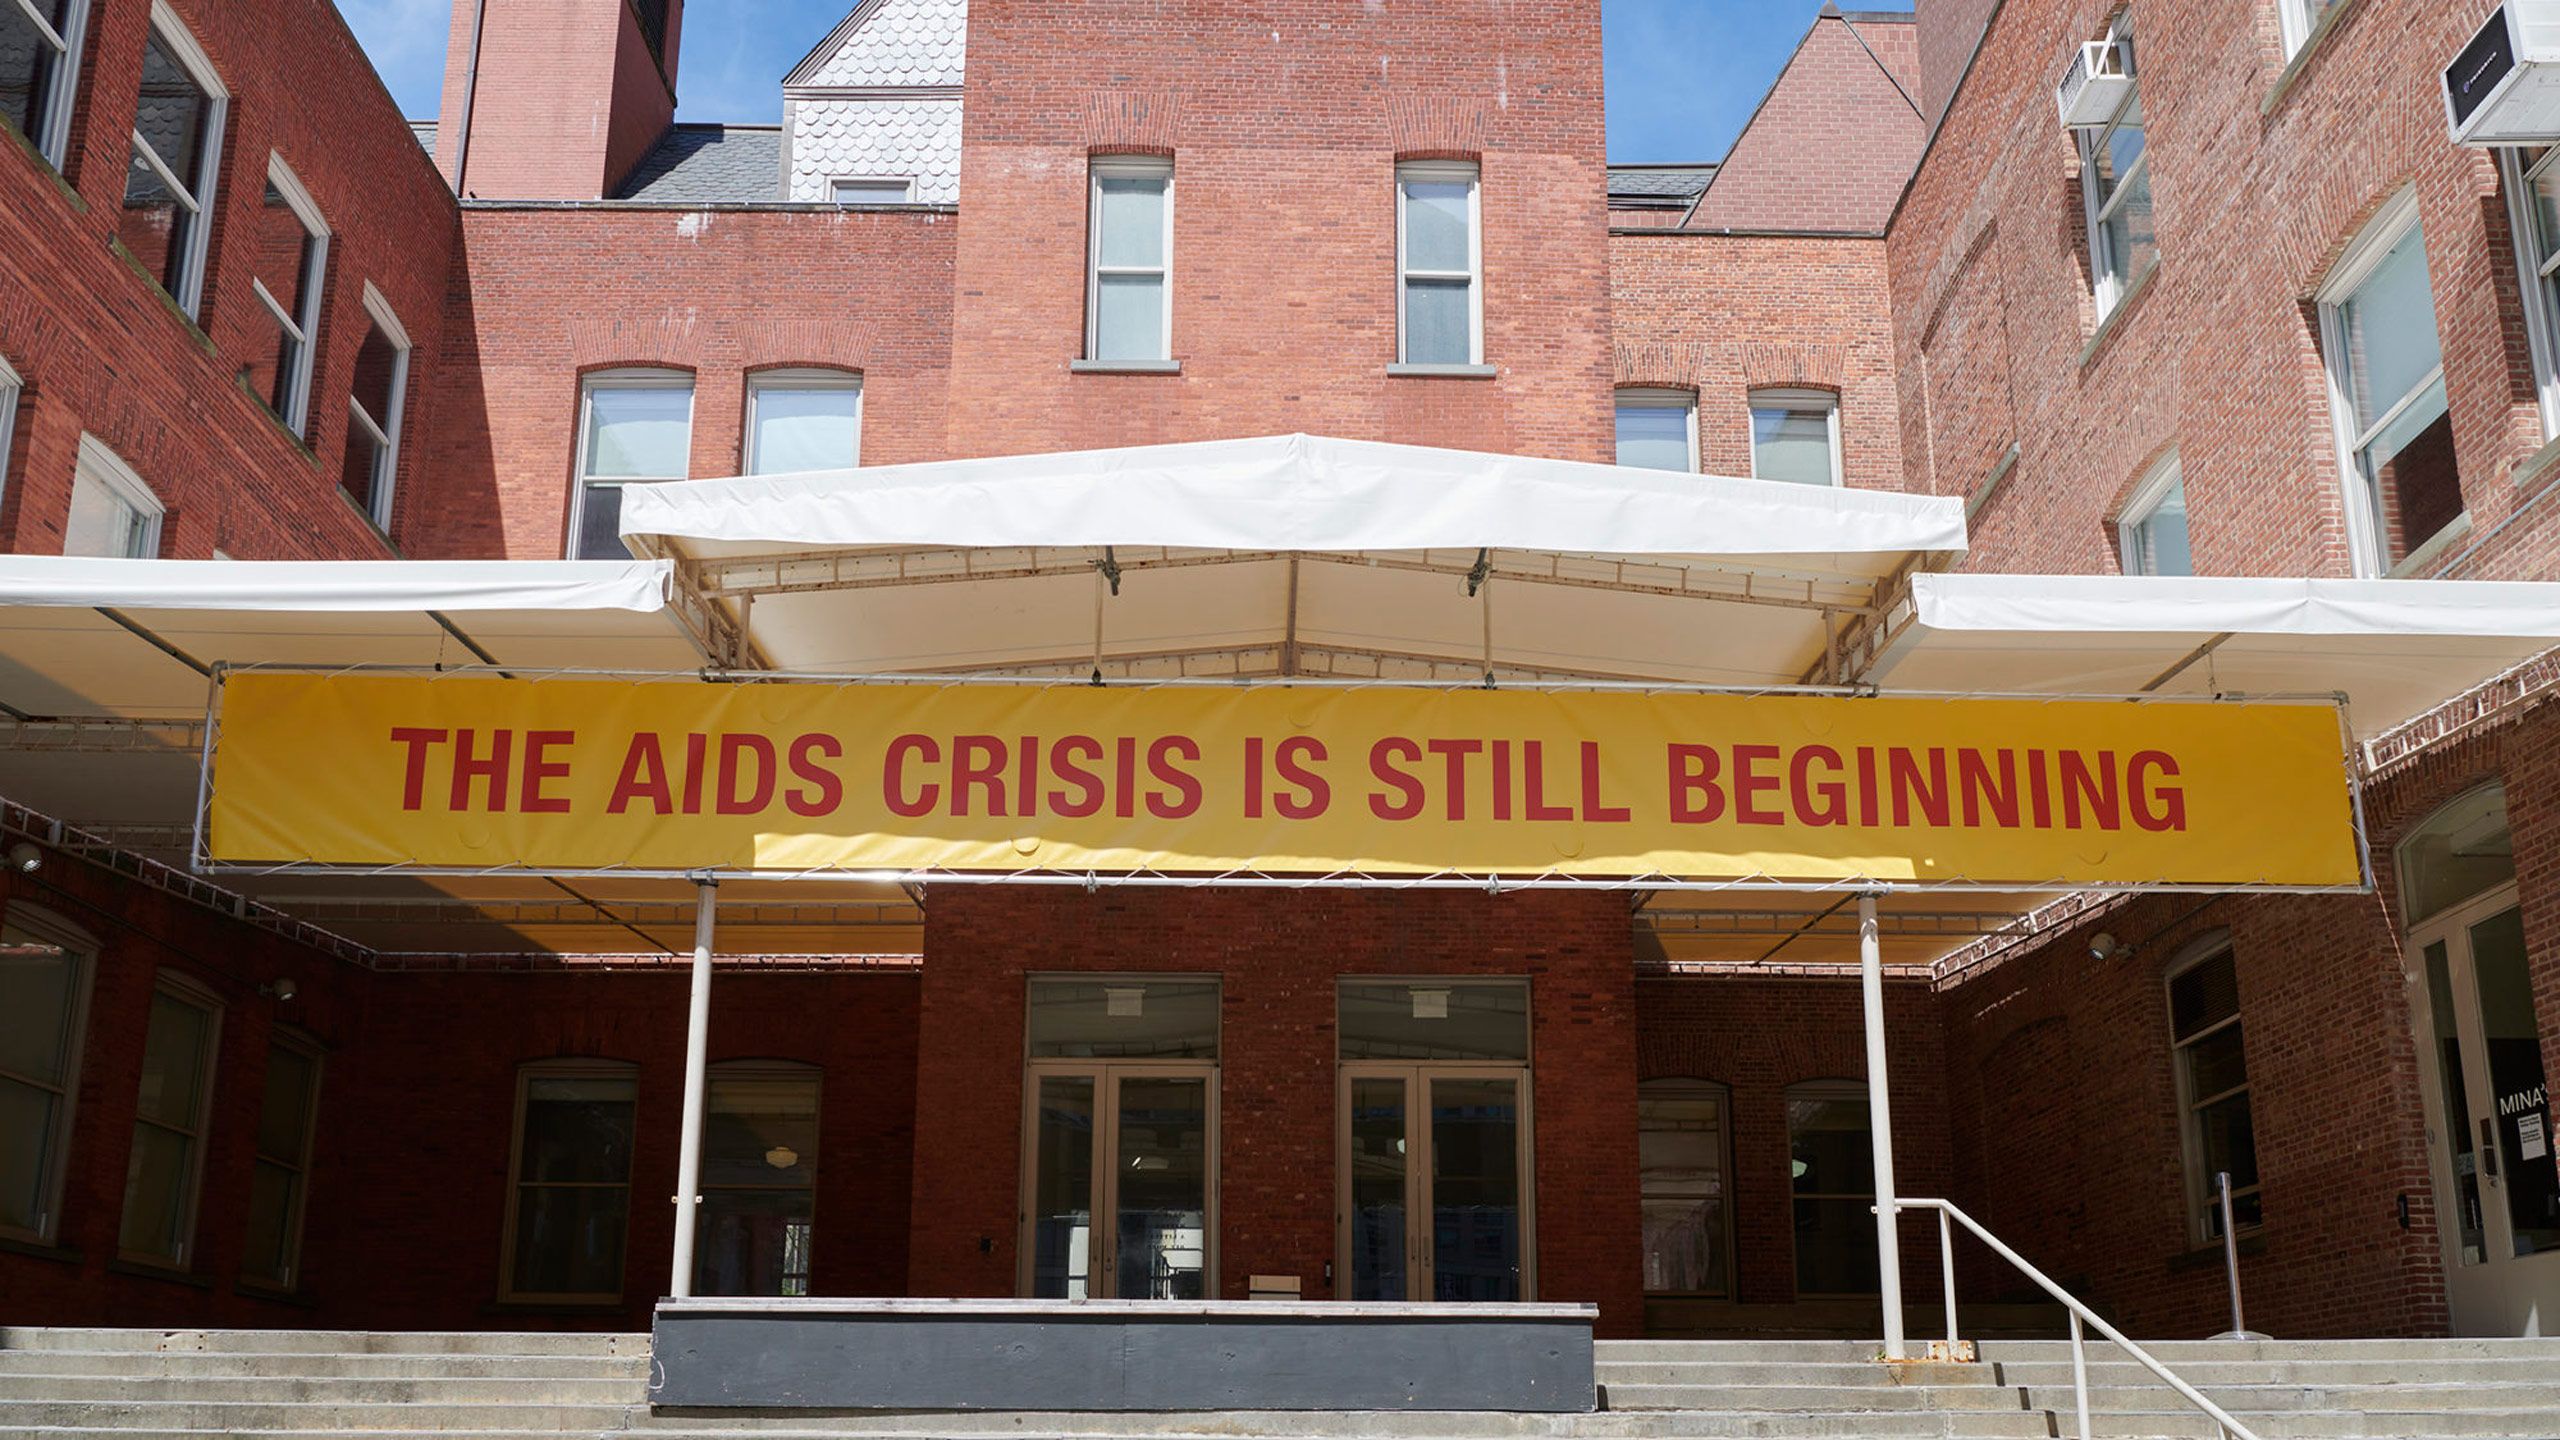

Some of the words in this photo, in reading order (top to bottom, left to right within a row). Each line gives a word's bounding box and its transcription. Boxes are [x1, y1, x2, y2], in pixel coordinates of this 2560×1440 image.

[390, 727, 575, 813] THE
[608, 732, 843, 818] AIDS
[884, 734, 1203, 820] CRISIS
[1245, 738, 1331, 820] IS
[1369, 738, 1631, 824] STILL
[1668, 744, 2187, 834] BEGINNING
[2499, 1083, 2548, 1116] MINA'
